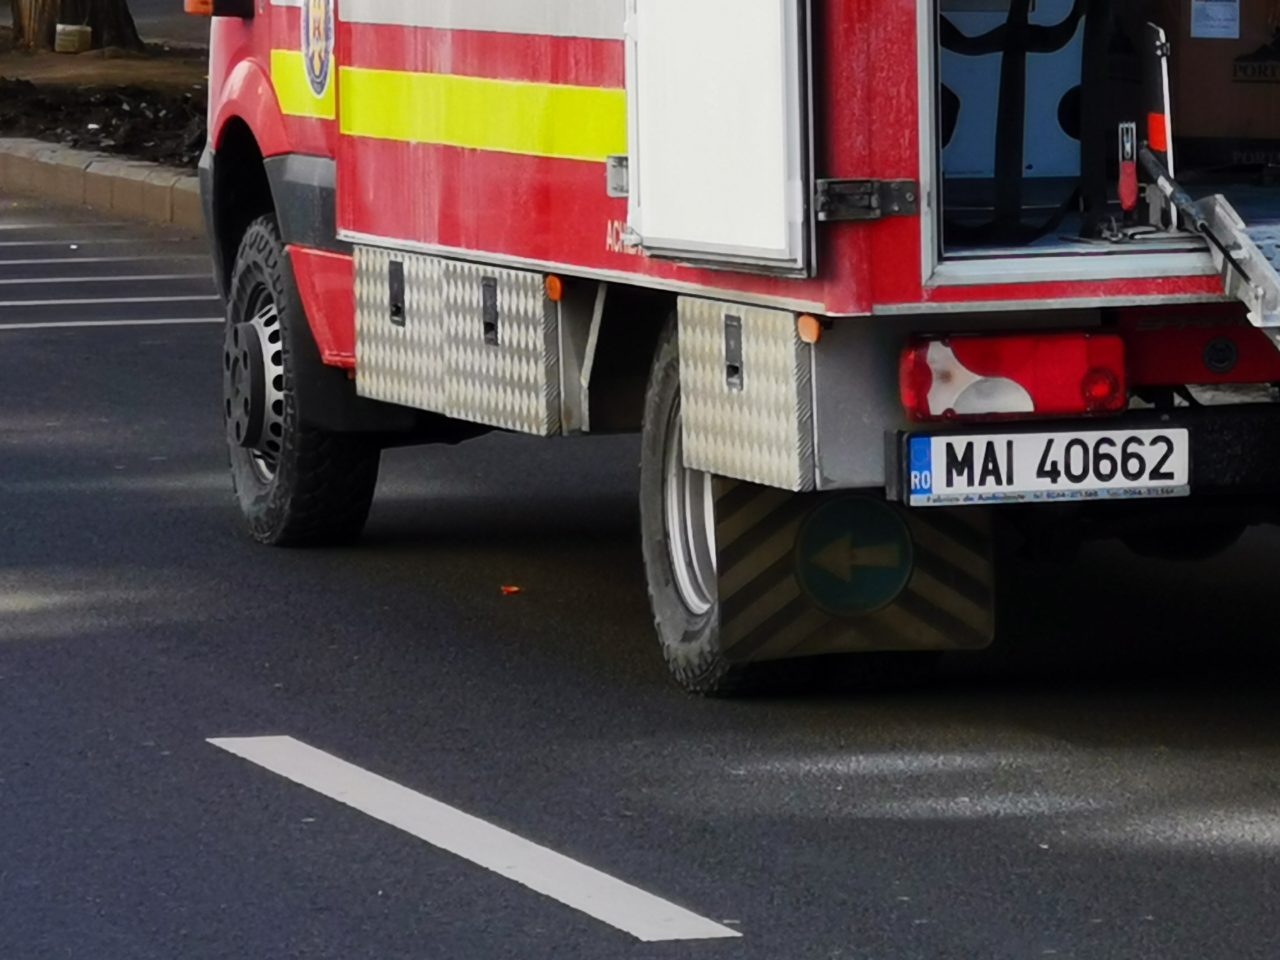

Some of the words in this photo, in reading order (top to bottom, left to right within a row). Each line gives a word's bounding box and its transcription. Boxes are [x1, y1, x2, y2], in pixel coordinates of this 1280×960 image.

[945, 440, 1014, 488] MAI
[1036, 435, 1175, 484] 40662
[911, 470, 931, 490] RO
